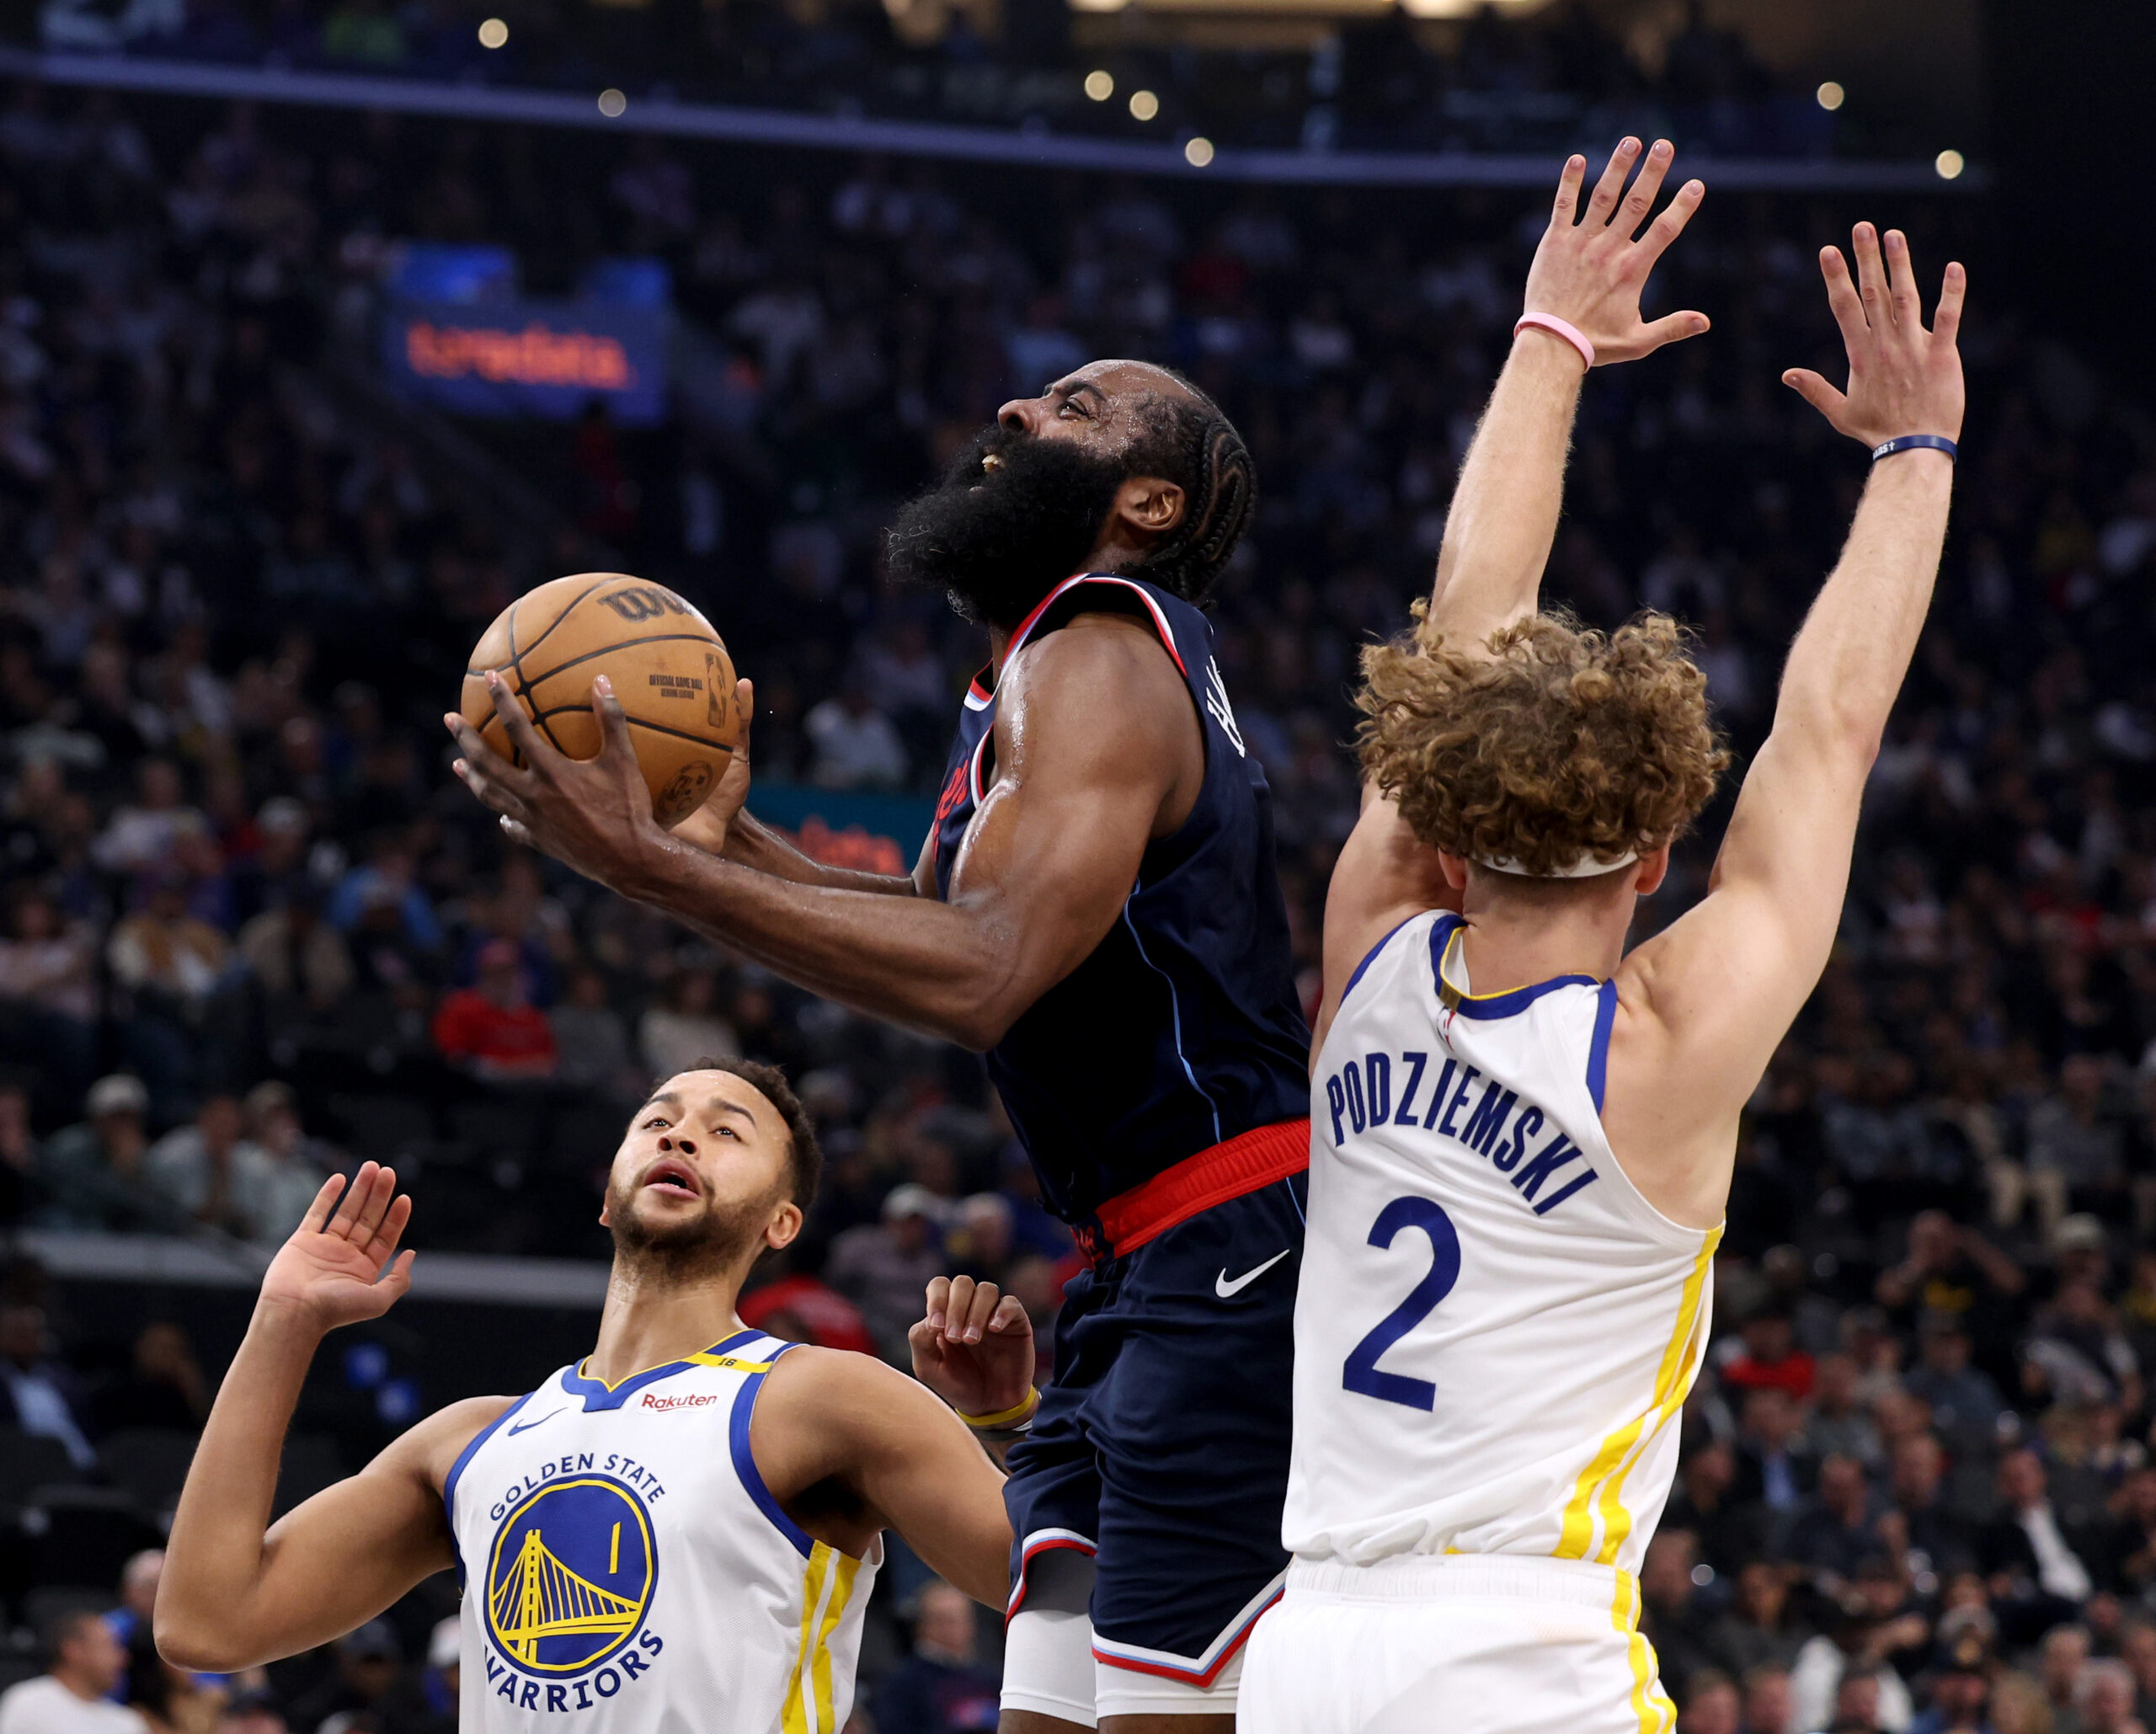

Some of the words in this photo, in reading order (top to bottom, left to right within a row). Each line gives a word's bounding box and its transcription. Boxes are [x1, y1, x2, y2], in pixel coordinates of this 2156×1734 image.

[1326, 1051, 1598, 1216] PODZIEMSKI
[1342, 1195, 1461, 1413] 2
[718, 1358, 738, 1367] 16
[642, 1394, 718, 1412] Rakuten
[490, 1453, 595, 1521] GOLDEN
[604, 1454, 665, 1503] STATE
[484, 1629, 664, 1713] WARRIORS
